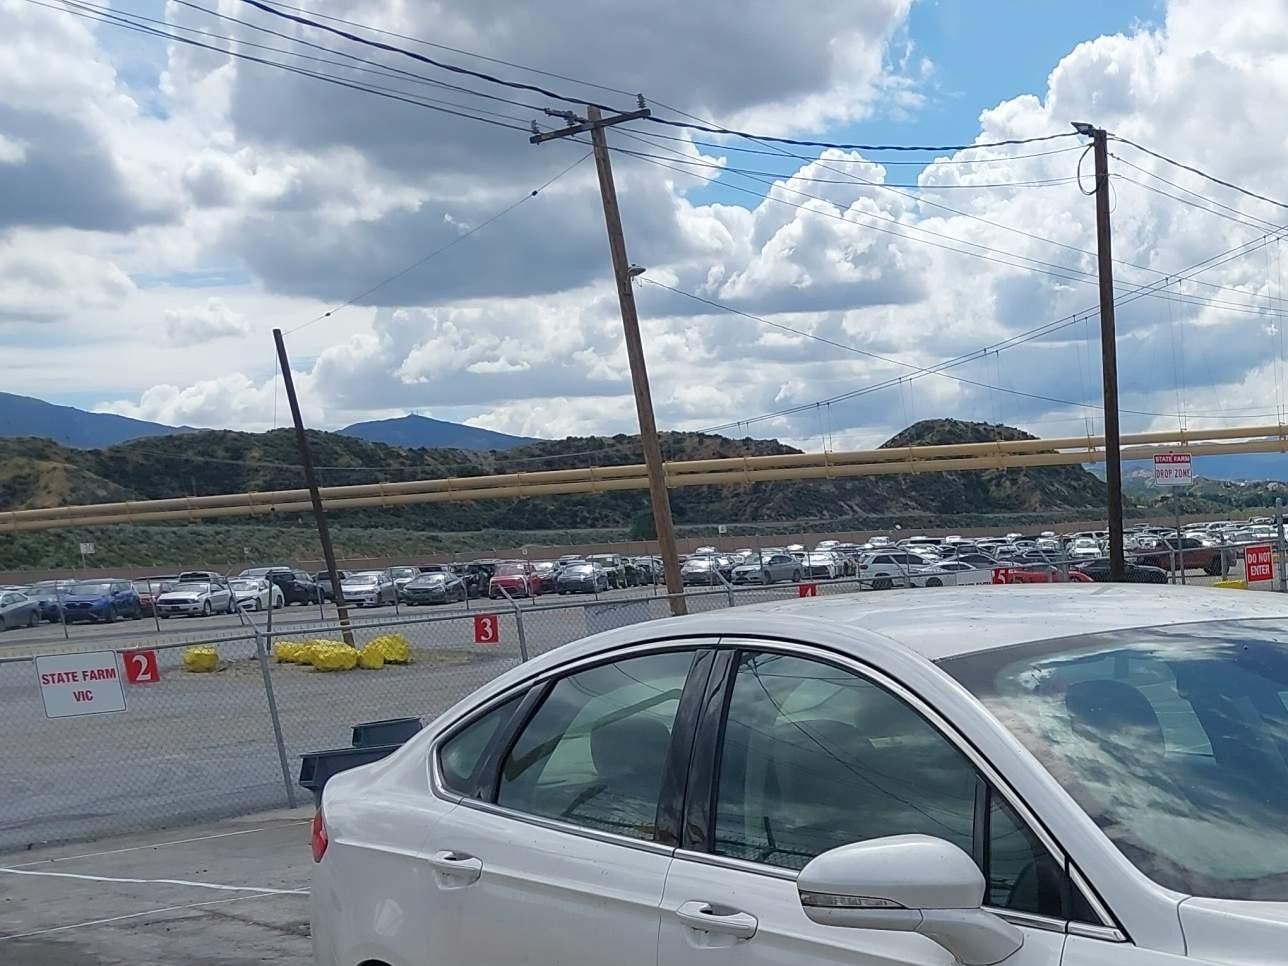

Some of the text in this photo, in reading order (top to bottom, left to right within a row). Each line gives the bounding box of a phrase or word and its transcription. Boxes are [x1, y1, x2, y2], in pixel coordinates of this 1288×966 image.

[1156, 468, 1191, 479] DROP ZONE
[1247, 551, 1271, 564] DO NOT
[1250, 564, 1270, 576] ENTER
[480, 617, 493, 641] 3
[132, 654, 152, 681] 2
[41, 667, 117, 685] STATE FARM
[73, 690, 93, 702] VIC
